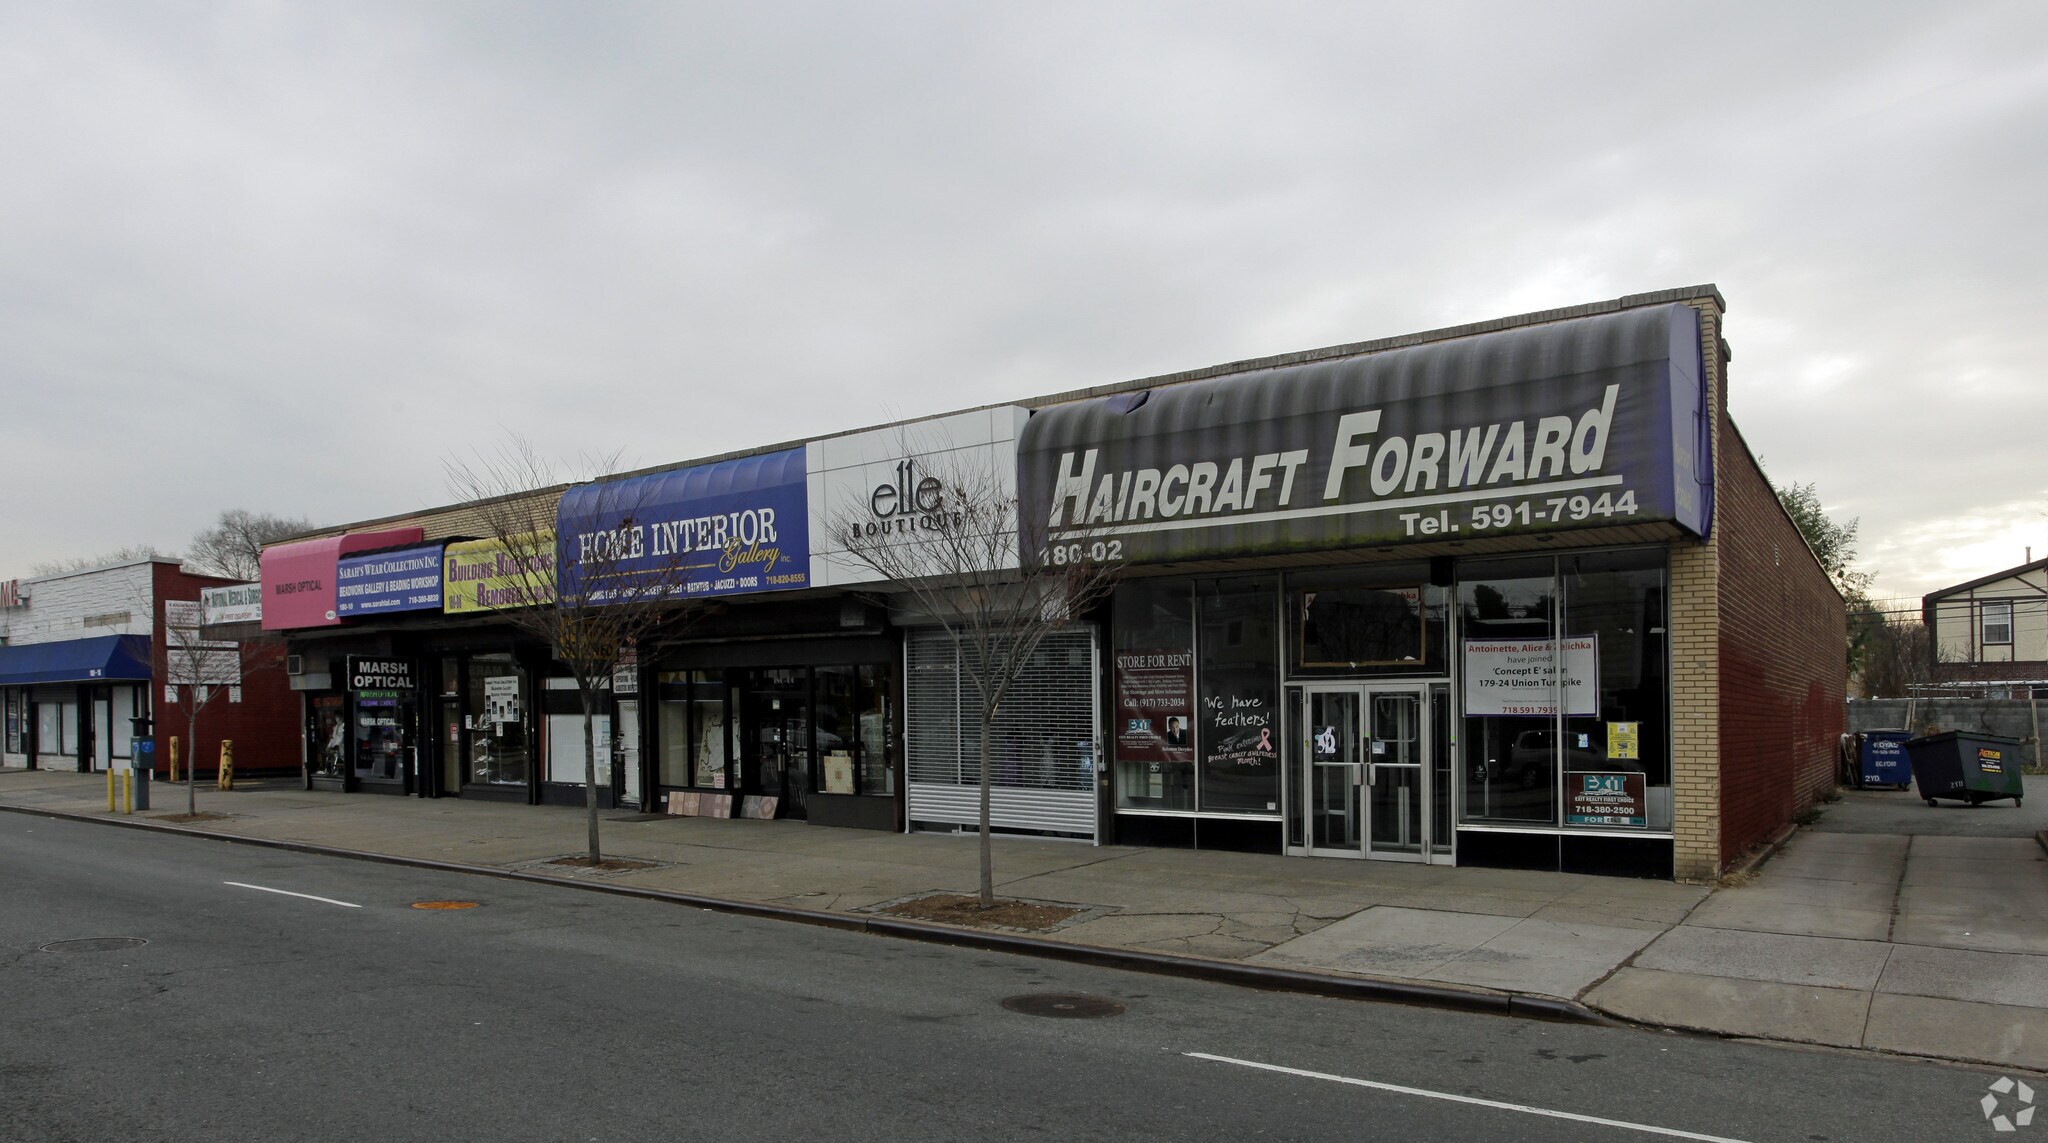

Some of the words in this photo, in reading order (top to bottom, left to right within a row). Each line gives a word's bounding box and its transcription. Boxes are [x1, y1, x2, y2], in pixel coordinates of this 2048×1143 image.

[871, 458, 942, 519] elle
[1399, 510, 1459, 536] Tel.
[1471, 490, 1638, 530] 591-7944
[852, 511, 964, 538] BOUTIQUE
[578, 526, 644, 565] HOME
[651, 507, 777, 556] INTERIOR
[718, 536, 780, 573] Gallery
[1038, 540, 1123, 567] 180-02
[339, 566, 364, 579] SARAH'S
[364, 563, 383, 576] WEAR
[383, 558, 424, 574] COLLECTION
[425, 556, 439, 568] INC.
[448, 558, 493, 583] BUILDING
[276, 583, 297, 595] MARSH
[297, 579, 322, 593] OPTICAL
[339, 584, 364, 597] BEADWORK
[365, 581, 385, 594] GALLERY
[389, 578, 410, 592] BEADING
[411, 576, 439, 590] WORKSHOP
[740, 576, 758, 588] DOORS
[1468, 644, 1520, 654] Antoinette,
[1521, 643, 1543, 652] Alice
[1545, 643, 1552, 652] &
[359, 661, 408, 674] MARSH
[1117, 655, 1146, 669] STORE
[1147, 655, 1166, 668] FOR
[1167, 653, 1191, 667] RENT
[1507, 656, 1527, 664] have
[1527, 655, 1553, 665] joined
[1543, 666, 1567, 675] saln
[353, 675, 414, 688] OPTICAL
[1479, 679, 1510, 688] 179-24
[1511, 678, 1539, 687] Union
[1541, 677, 1582, 688] Turpike
[1124, 698, 1139, 707] Call:
[1139, 698, 1156, 709] (917)
[1157, 698, 1185, 707] 733-2034
[1205, 695, 1225, 709] We
[1231, 694, 1263, 709] have
[1214, 712, 1270, 727] feathers!
[1228, 750, 1247, 759] cancer
[1247, 750, 1278, 759] awareness
[1575, 805, 1635, 815] 718-380-2500
